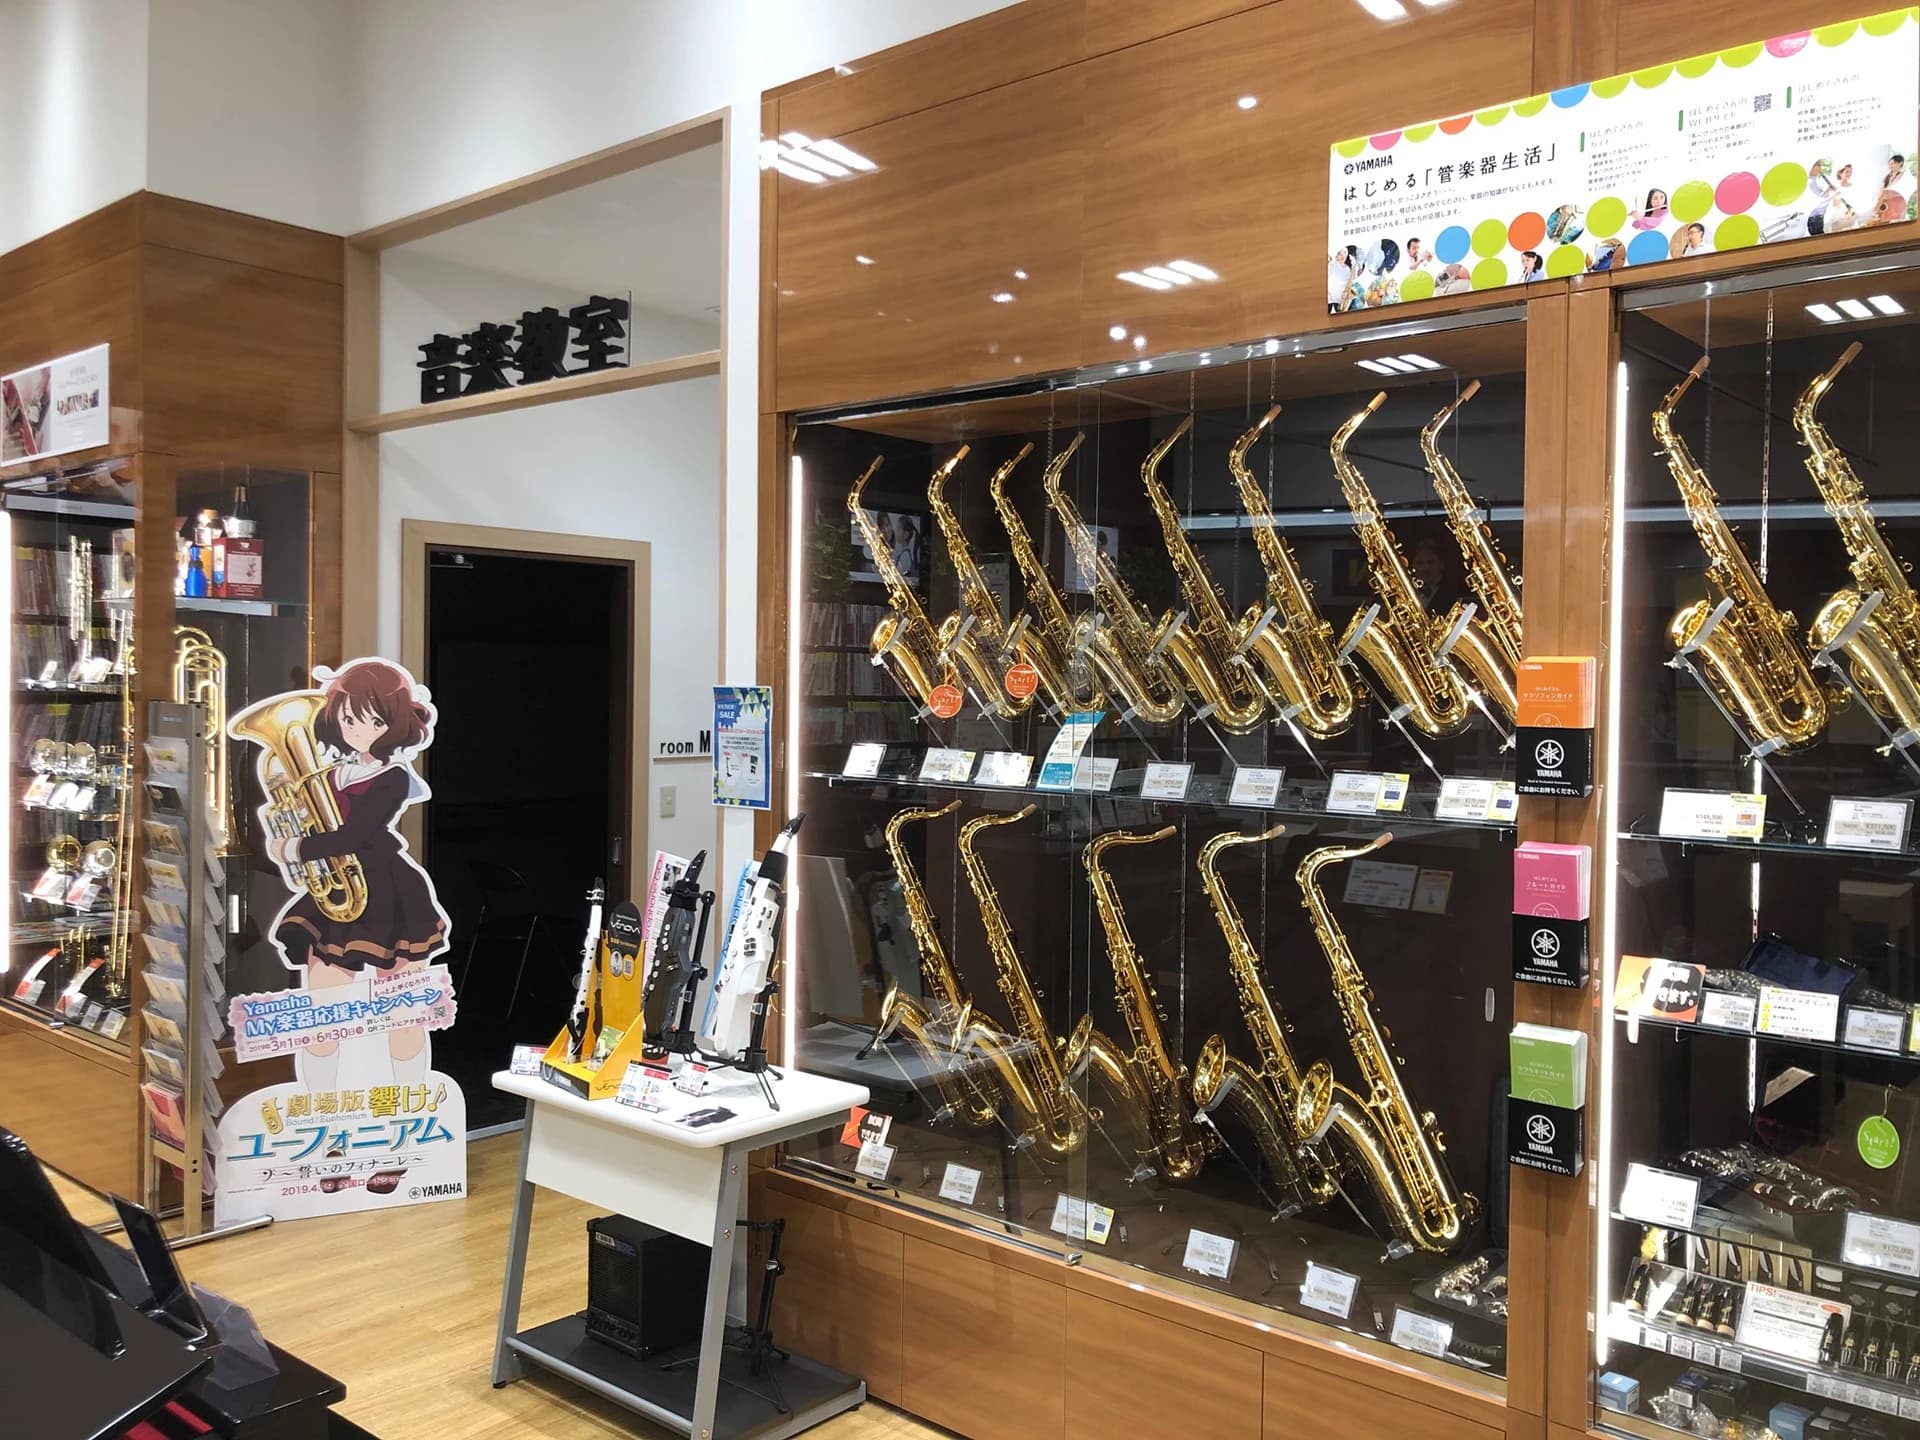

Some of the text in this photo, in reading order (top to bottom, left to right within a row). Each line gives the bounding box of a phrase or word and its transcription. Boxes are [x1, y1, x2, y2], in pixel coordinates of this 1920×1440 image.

[1343, 143, 1556, 202] はじめる「管楽器生活」
[1356, 155, 1393, 173] YAMAHA
[416, 295, 630, 404] 音楽教室
[659, 741, 694, 755] room
[699, 730, 711, 753] M
[1536, 769, 1563, 778] YAMAHA
[1532, 957, 1559, 969] YAMAHA
[244, 995, 312, 1018] Yamaha
[244, 988, 443, 1037] My楽器応援キャンペーン
[285, 1089, 366, 1118] 劇場版
[227, 1116, 456, 1163] ユーフォニアム
[1527, 1142, 1554, 1155] YAMAHA
[421, 1182, 463, 1199] YAMAHA
[1750, 1283, 1777, 1297] TIPS!
